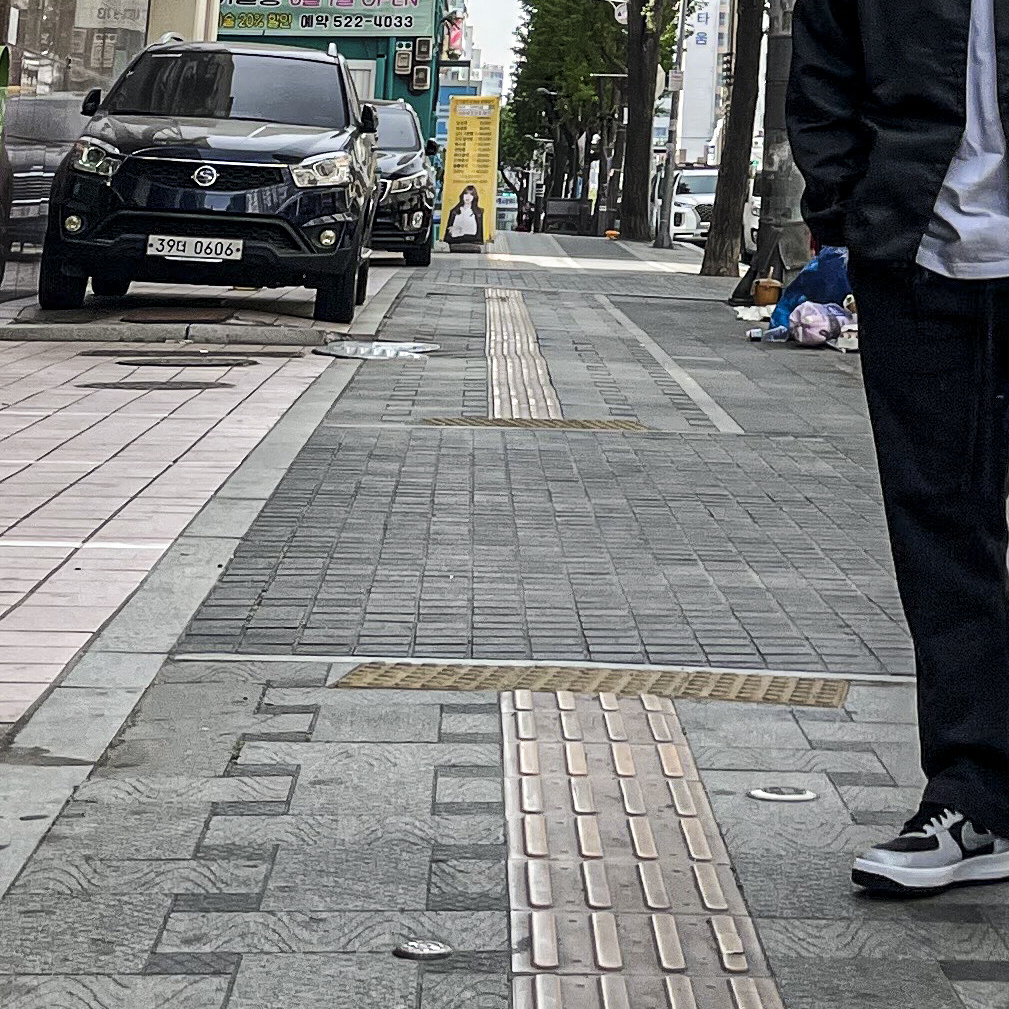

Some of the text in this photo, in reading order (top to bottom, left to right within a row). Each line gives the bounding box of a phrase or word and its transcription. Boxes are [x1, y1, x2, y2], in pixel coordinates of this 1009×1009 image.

[238, 12, 265, 29] 20%
[266, 12, 293, 30] 할인
[300, 14, 330, 29] 예약
[333, 14, 414, 29] 522-4033
[194, 240, 234, 257] 0606
